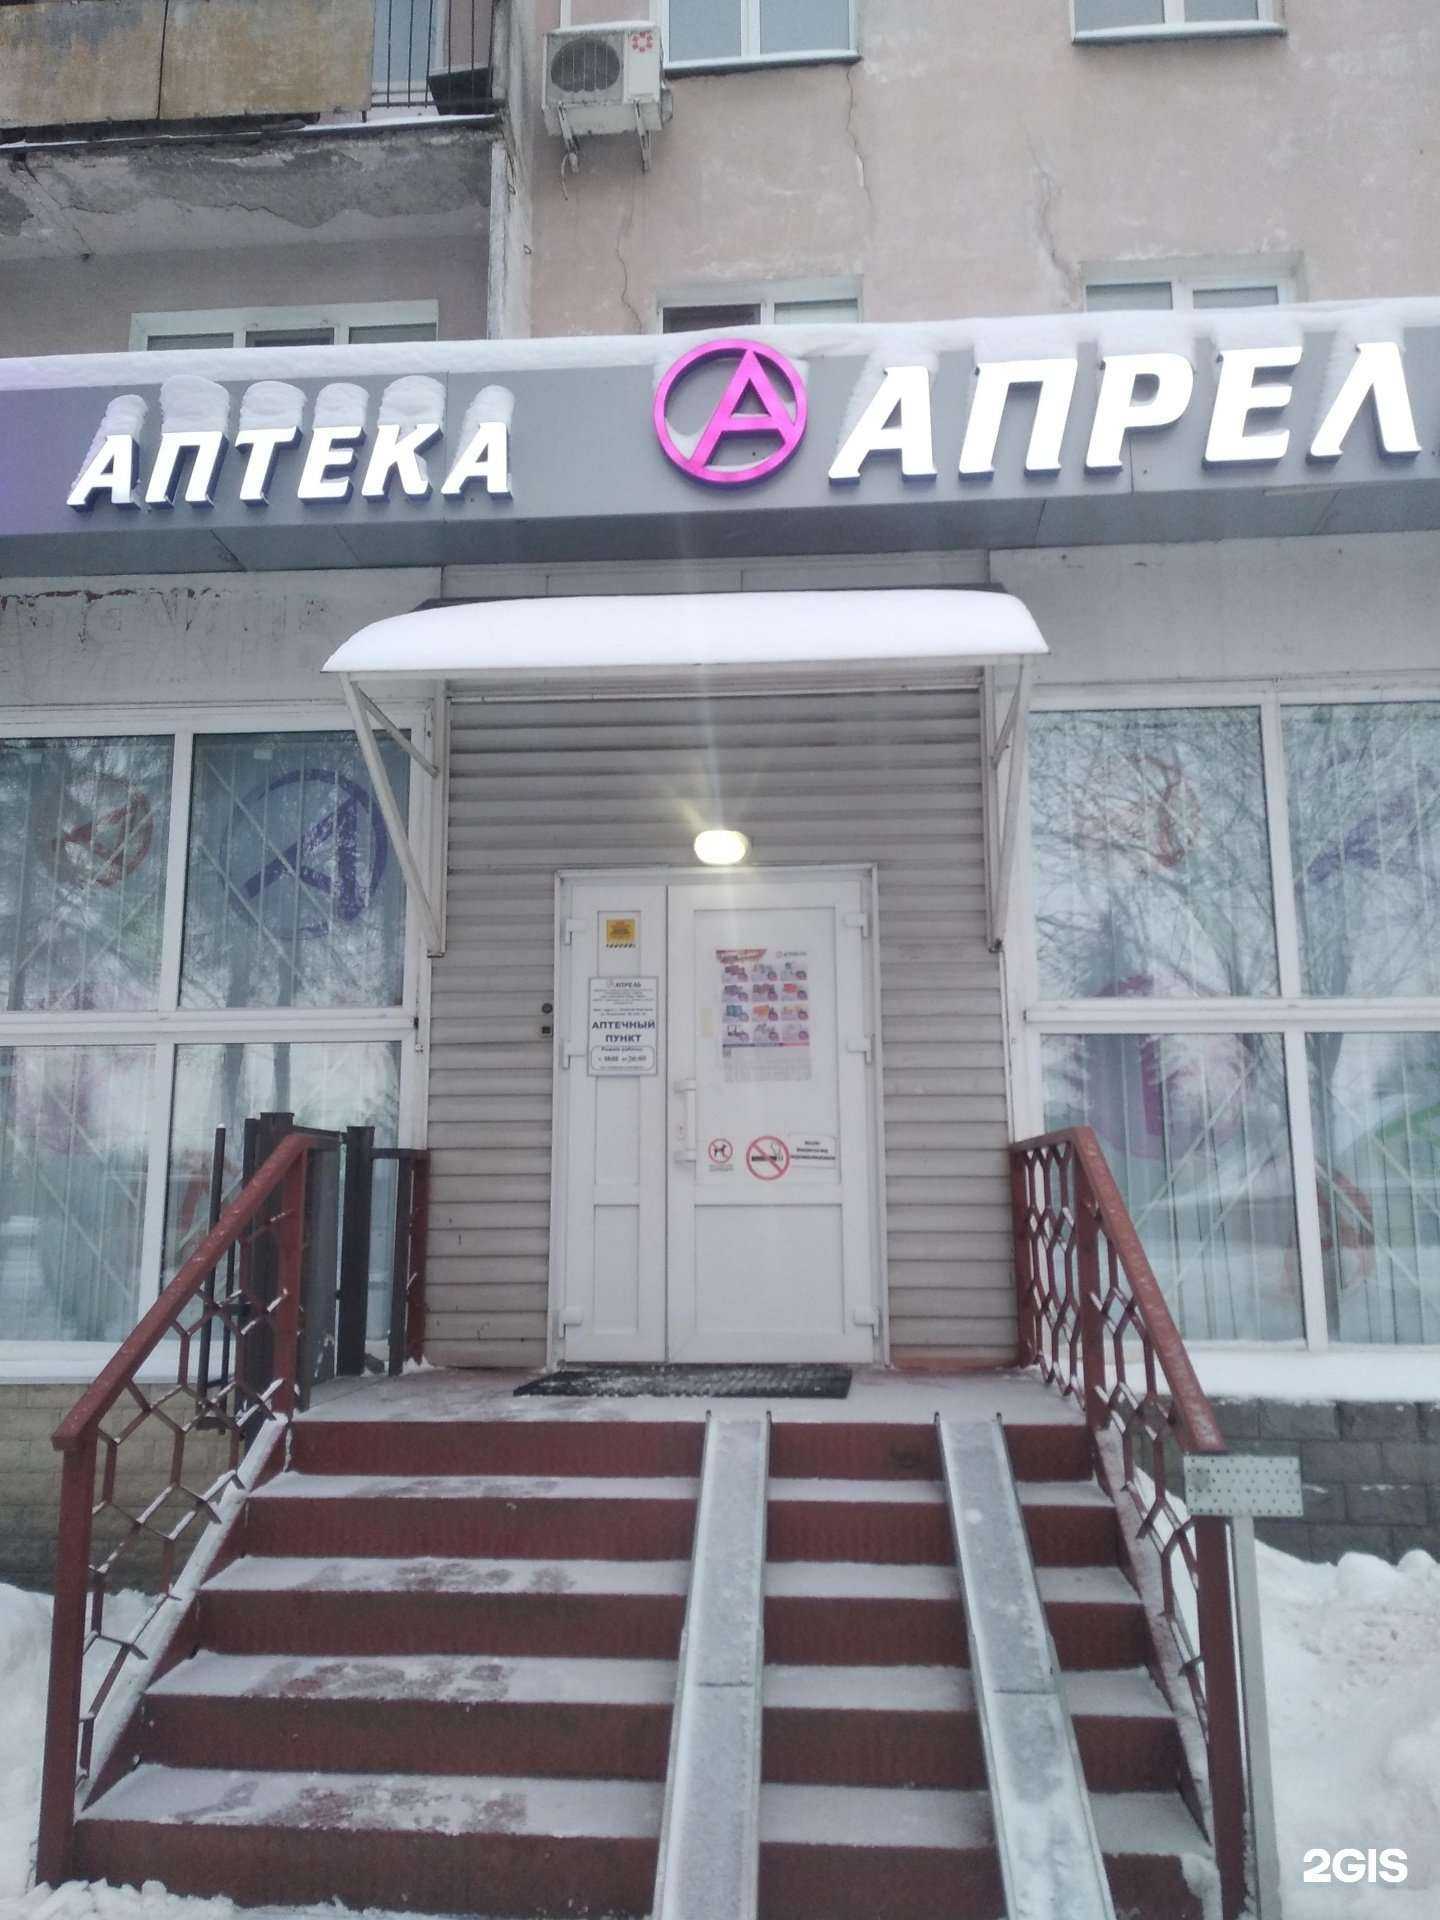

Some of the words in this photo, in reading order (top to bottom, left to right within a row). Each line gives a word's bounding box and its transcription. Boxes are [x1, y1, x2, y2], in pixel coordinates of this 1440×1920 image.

[828, 341, 1422, 486] АПРЕЛ
[67, 420, 514, 508] АПТЕКА
[592, 1020, 656, 1029] АПТЕЧНЫЙ
[605, 1034, 641, 1043] ПУНКТ
